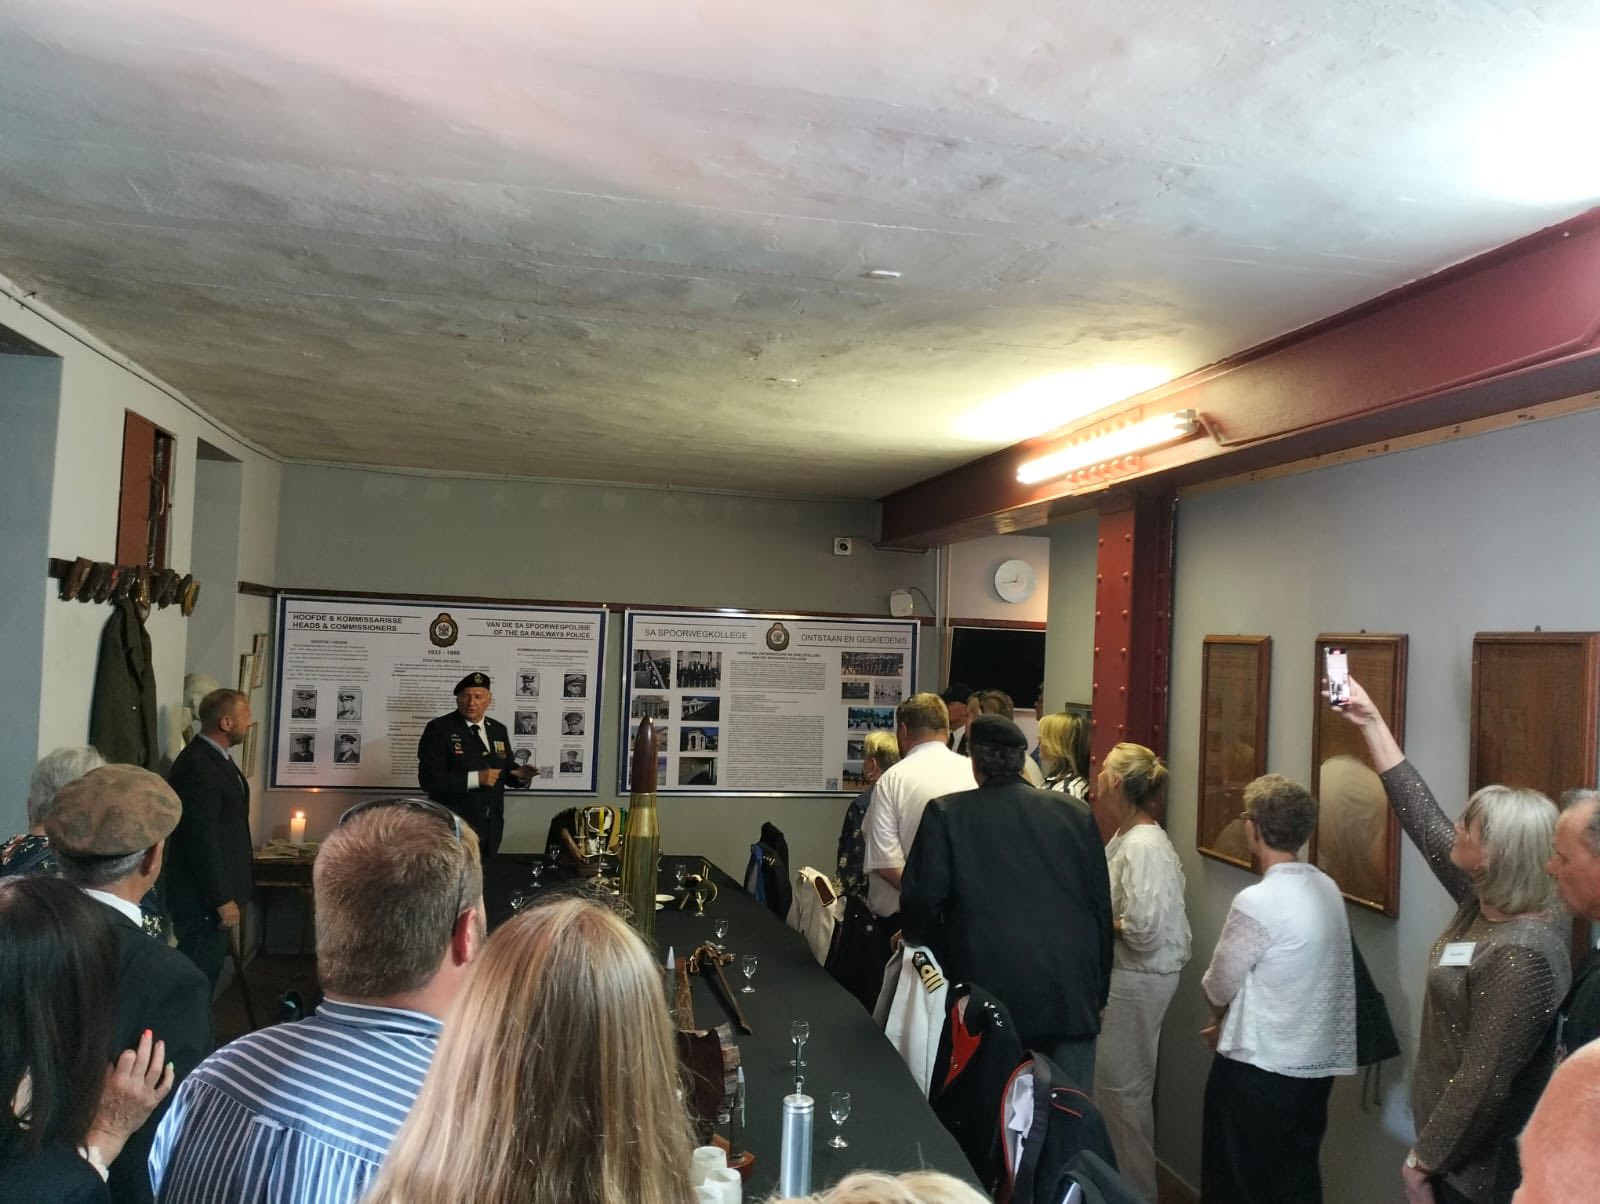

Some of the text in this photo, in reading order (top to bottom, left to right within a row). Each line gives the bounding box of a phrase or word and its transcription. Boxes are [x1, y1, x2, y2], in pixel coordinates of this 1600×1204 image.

[293, 614, 327, 622] HOOFDE
[337, 615, 403, 624] KOMMISSARISSE
[330, 623, 398, 632] COMMISSIONERS
[525, 622, 591, 631] SPOORWEGPOLISIE
[566, 631, 590, 639] POLICE
[644, 628, 749, 639] SA SPOORWEGKOLLEGE
[801, 633, 908, 645] ONTSTAAN EN GESKIEDENIS
